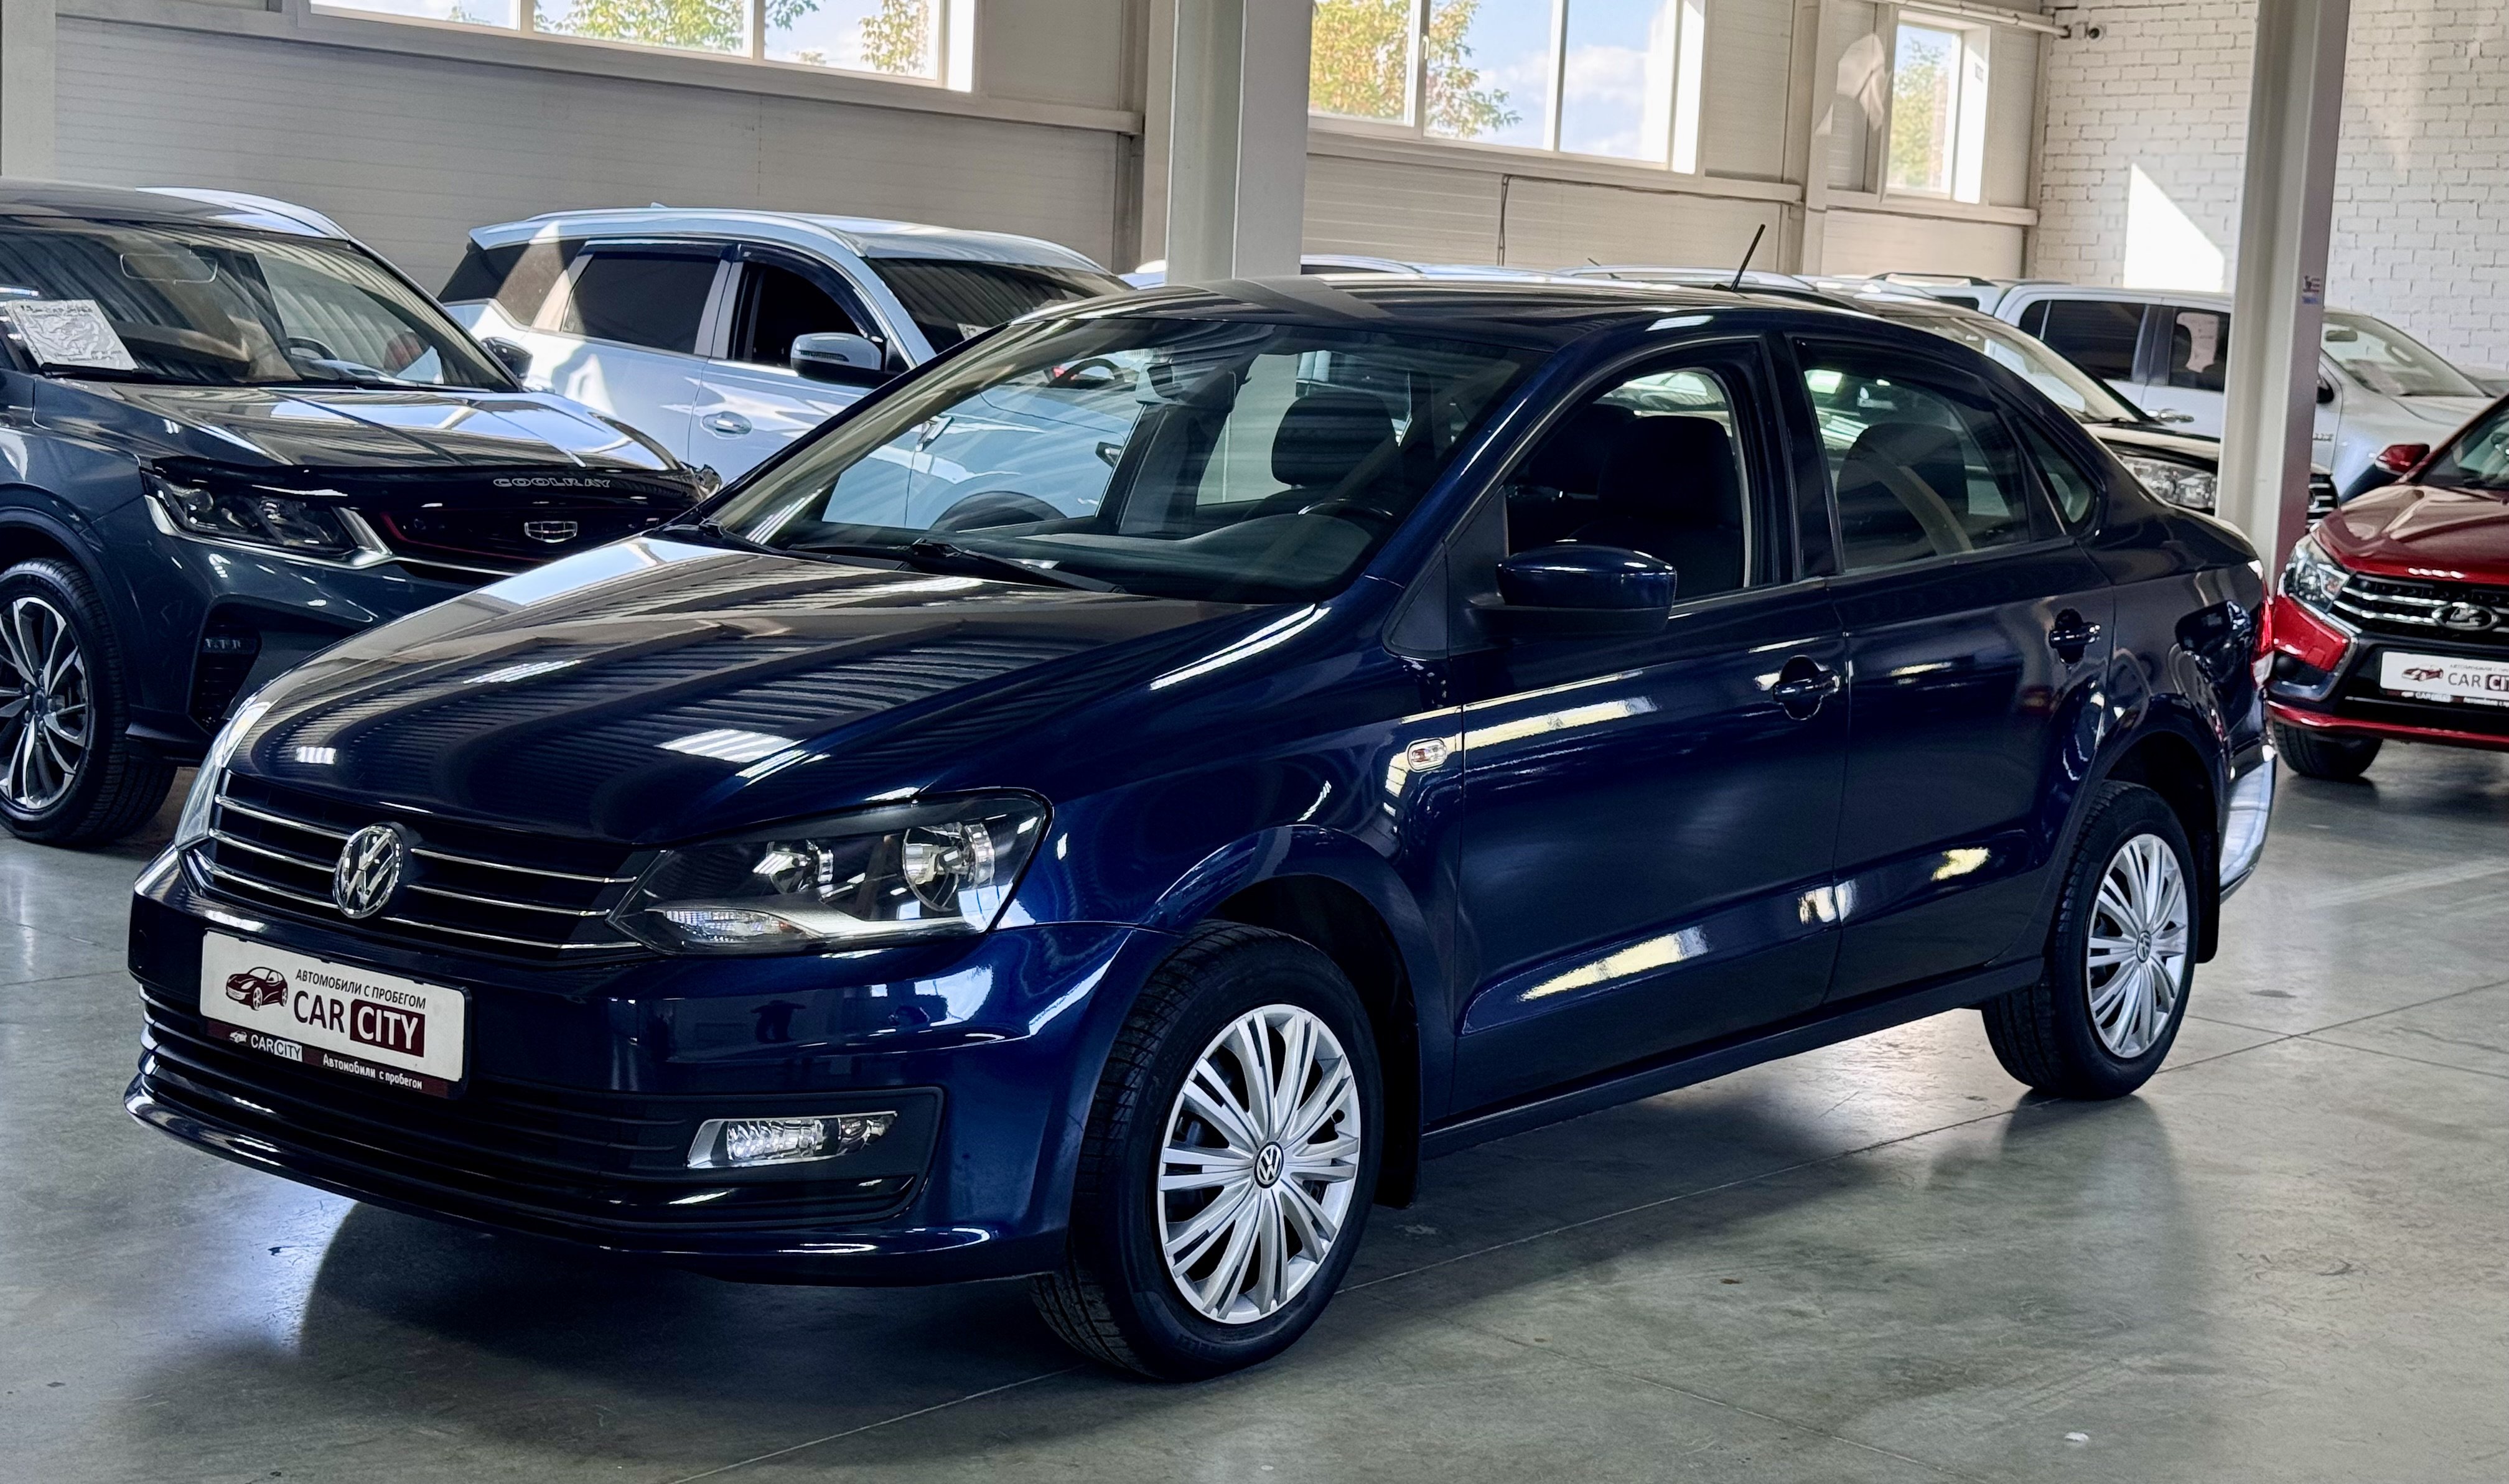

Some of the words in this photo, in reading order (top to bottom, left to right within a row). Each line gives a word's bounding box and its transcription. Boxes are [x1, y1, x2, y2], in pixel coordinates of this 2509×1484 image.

[493, 477, 610, 488] COOLRAY
[2448, 673, 2481, 688] CAR
[296, 969, 362, 996] АВТОМОБИЛИ
[364, 985, 371, 997] С
[372, 987, 426, 1010] ПРОБЕГОМ
[294, 990, 345, 1034] CAR
[357, 1006, 419, 1050] CITY
[323, 1053, 376, 1079] Автомобили
[385, 1072, 423, 1090] пробегом
